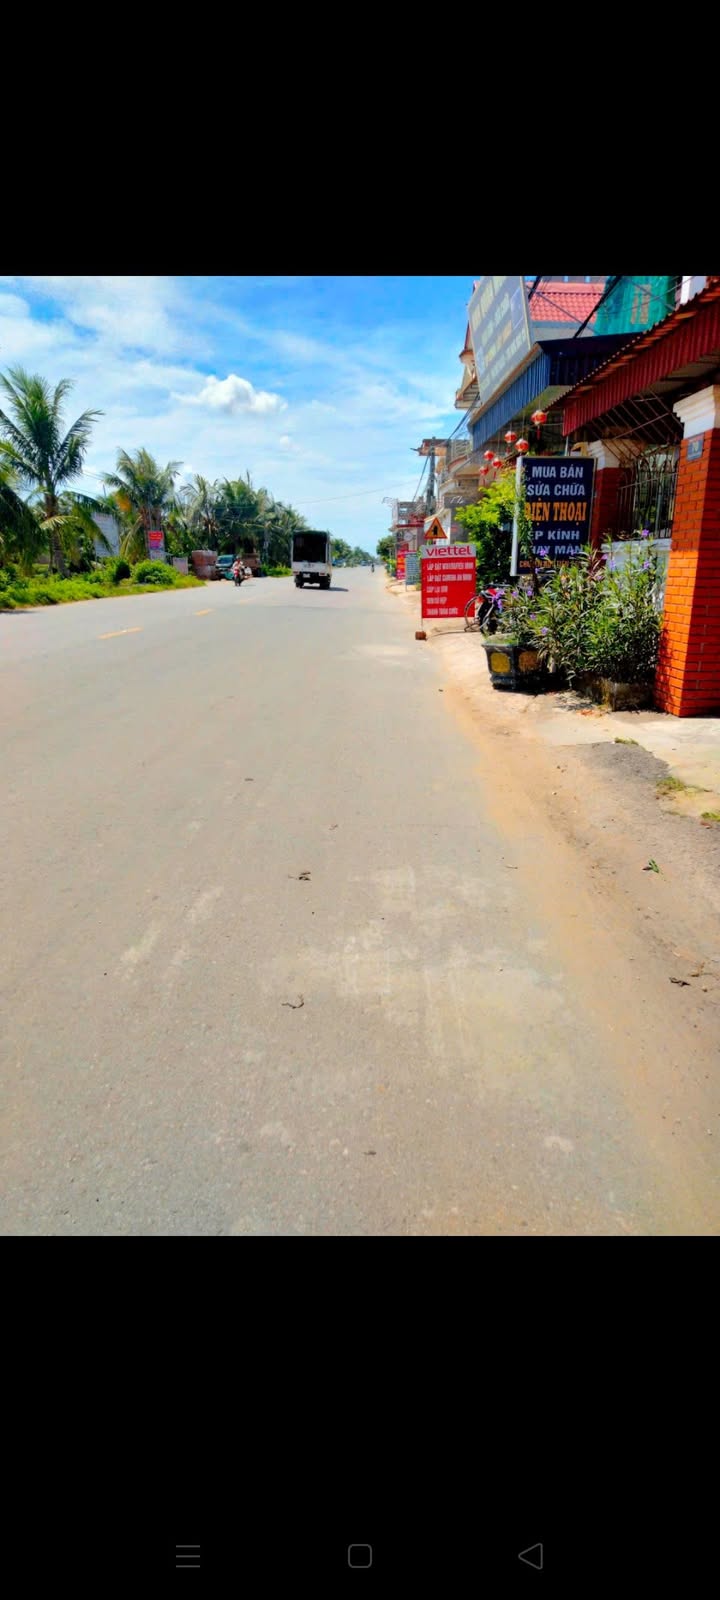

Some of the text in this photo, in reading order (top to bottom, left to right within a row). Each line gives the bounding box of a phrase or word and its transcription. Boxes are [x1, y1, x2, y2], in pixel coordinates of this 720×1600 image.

[532, 464, 583, 478] MUA BÁN
[527, 481, 585, 496] SỬA CHỮA
[553, 502, 587, 526] THOẠI
[548, 528, 580, 540] KÍNH
[426, 546, 472, 556] viettel
